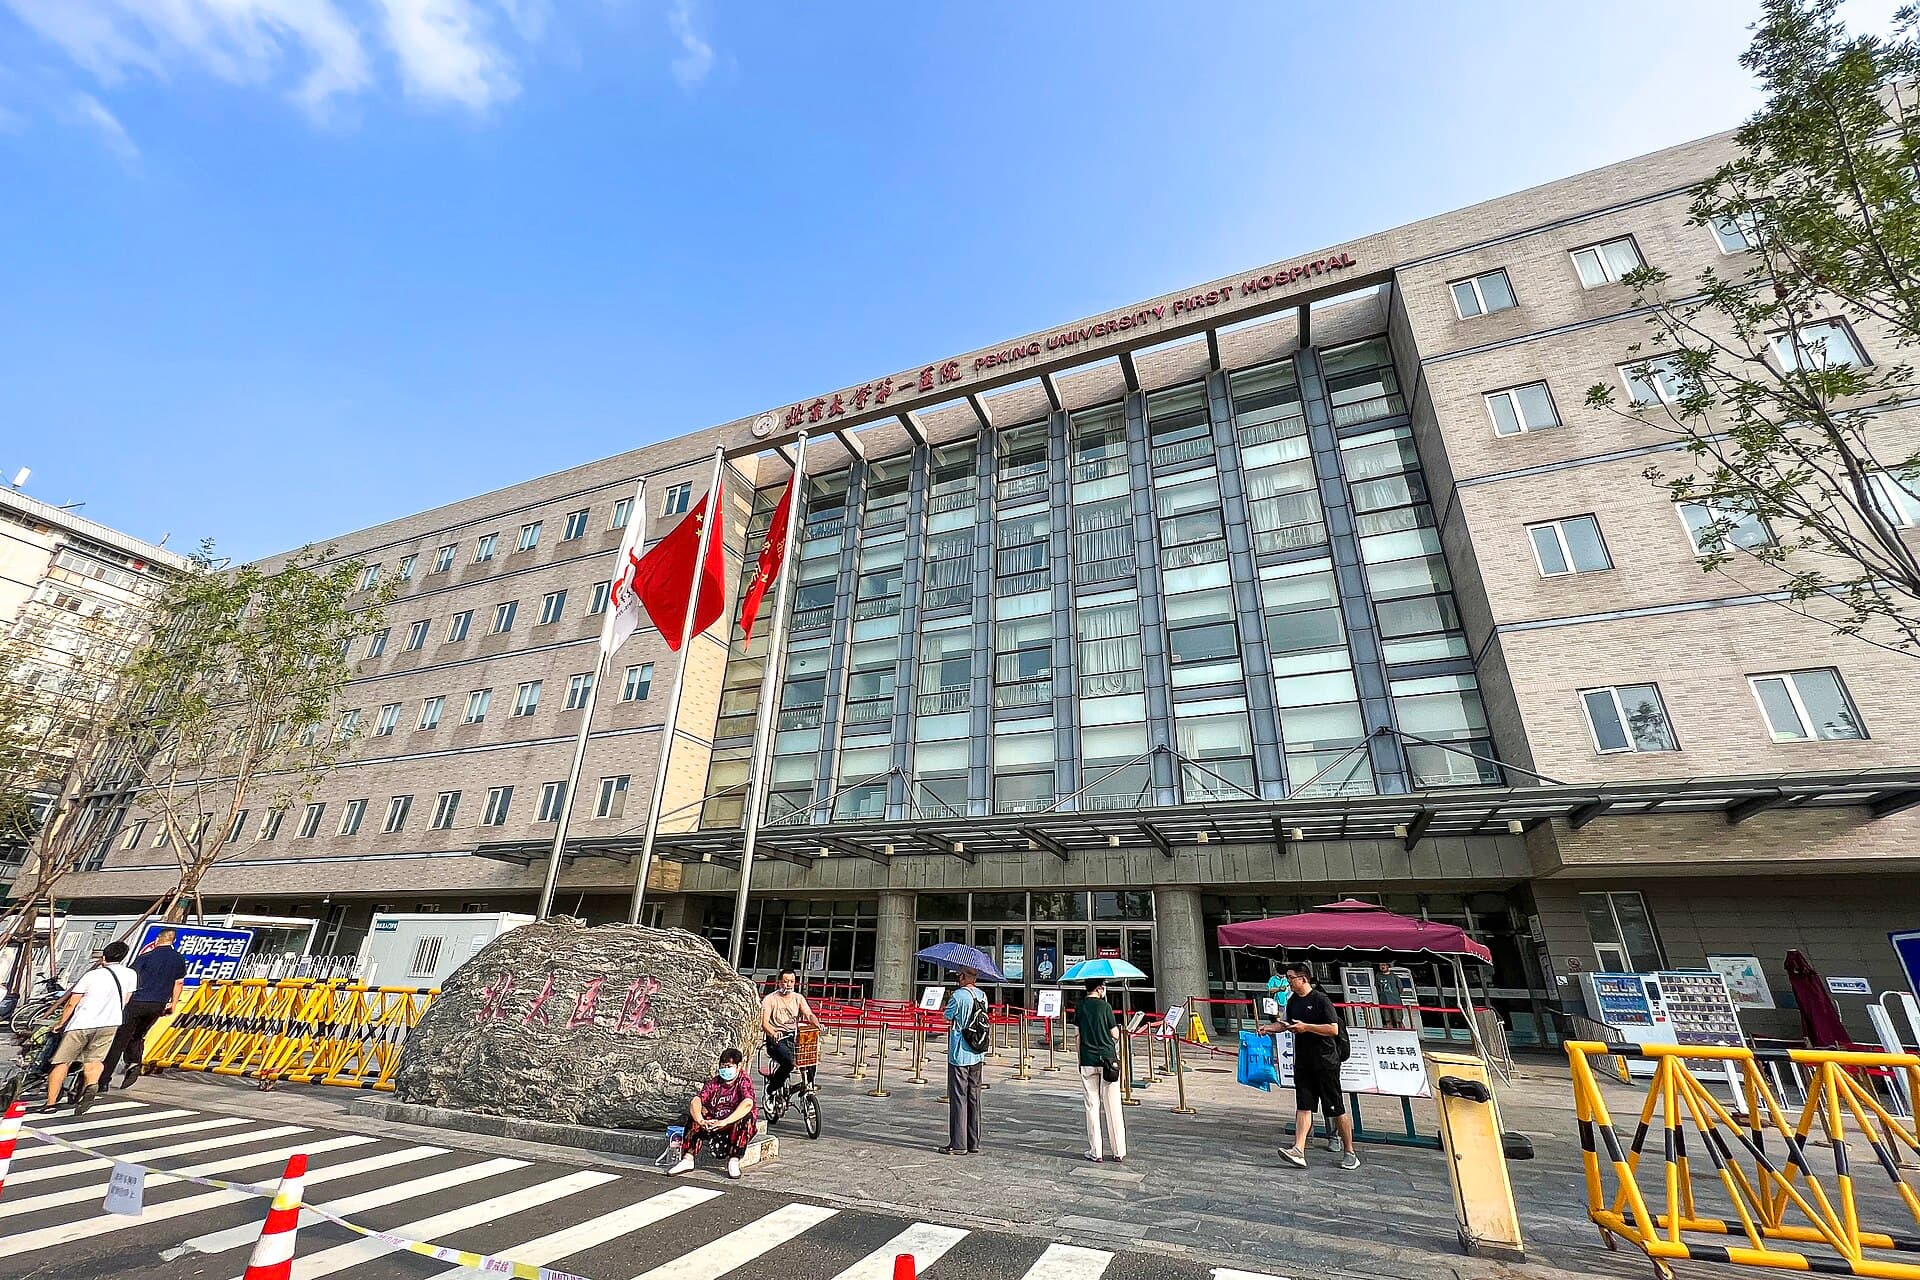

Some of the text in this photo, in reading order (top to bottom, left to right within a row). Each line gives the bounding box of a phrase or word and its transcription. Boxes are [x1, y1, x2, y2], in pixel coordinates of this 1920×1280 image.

[975, 252, 1357, 371] PEKING UNIVERSITY FIRST HOSPITAL
[784, 360, 962, 430] 北京大学第一医院
[177, 935, 246, 957] 消防车道
[184, 960, 237, 979] 止占用
[476, 970, 662, 1034] 北大医院
[1376, 1046, 1417, 1057] 社会车辆
[1379, 1060, 1420, 1072] 禁止入内
